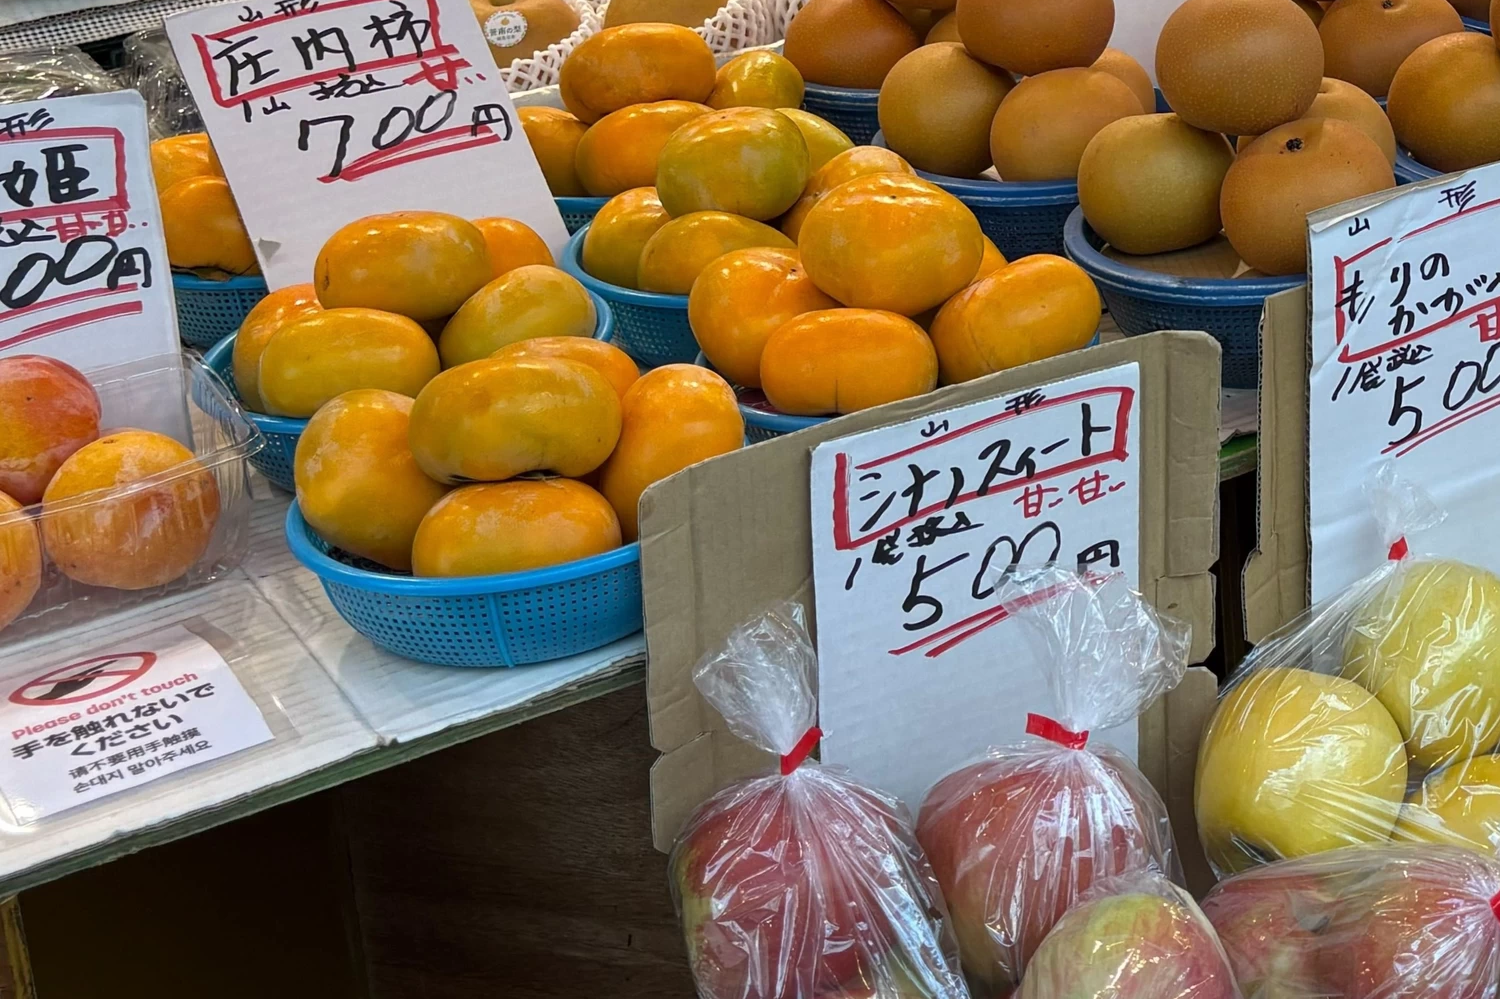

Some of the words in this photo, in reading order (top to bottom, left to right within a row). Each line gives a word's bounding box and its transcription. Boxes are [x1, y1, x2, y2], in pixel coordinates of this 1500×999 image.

[212, 0, 430, 96] 庄内柿
[298, 89, 513, 178] 700円
[1348, 180, 1477, 237] 山形
[1335, 252, 1450, 325] もりの
[920, 388, 1047, 437] 山形
[859, 402, 1112, 532] シナノスイート
[902, 521, 1121, 631] 500円
[10, 682, 216, 760] 手を触れないで
[11, 711, 82, 740] Please
[86, 692, 139, 716] don't
[141, 671, 199, 696] touch
[70, 714, 184, 757] ください
[73, 769, 125, 794] 손대지
[127, 740, 213, 776] 말아주세요
